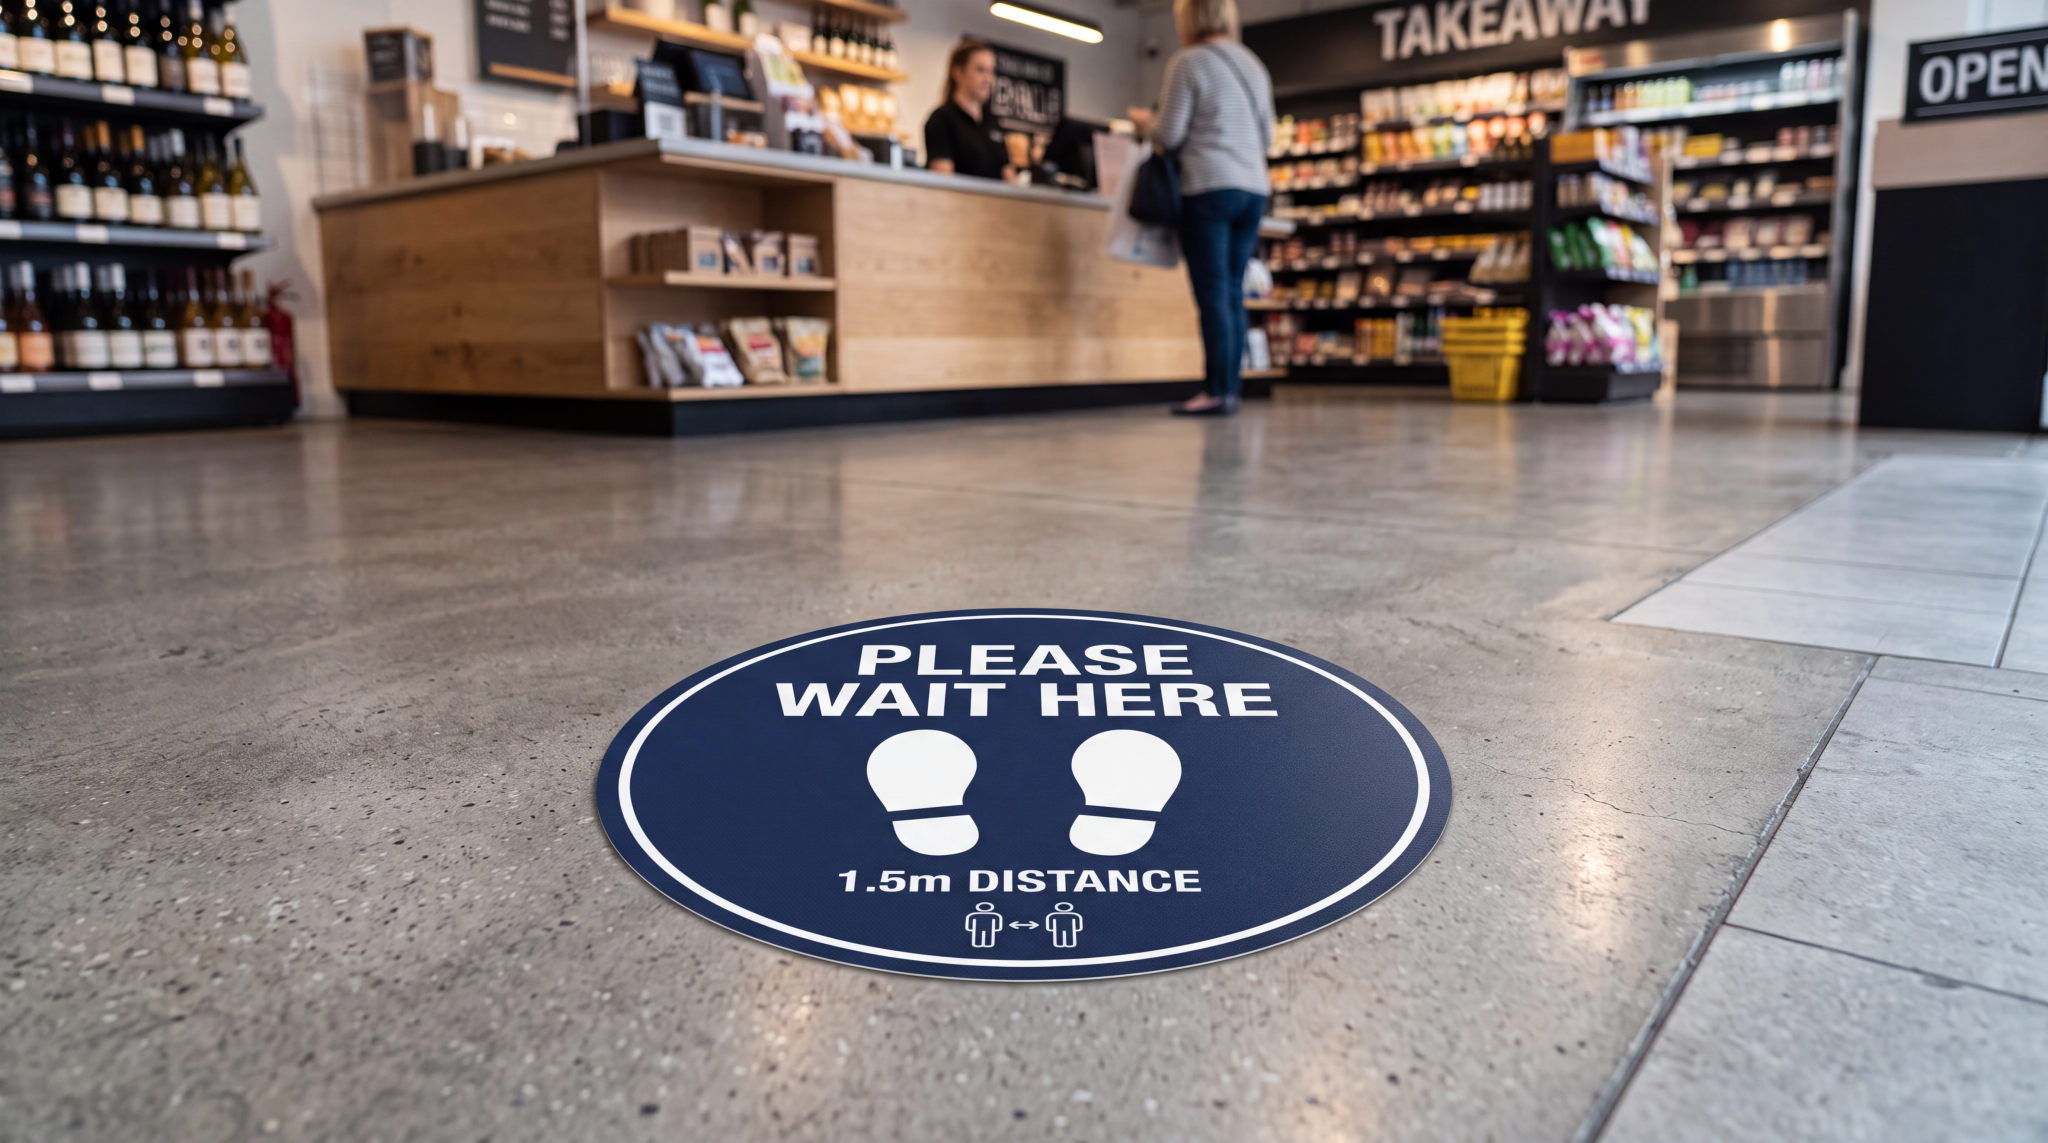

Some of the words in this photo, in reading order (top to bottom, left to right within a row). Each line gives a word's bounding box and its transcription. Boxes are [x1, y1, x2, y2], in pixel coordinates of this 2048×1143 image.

[1373, 0, 1650, 61] TAKEAWAY
[1919, 43, 2048, 104] OPEN
[857, 644, 1194, 676] PLEASE
[775, 682, 1007, 717] WAIT
[1040, 682, 1279, 717] HERE
[838, 869, 951, 893] 1.5m
[969, 869, 1202, 893] DISTANCE
